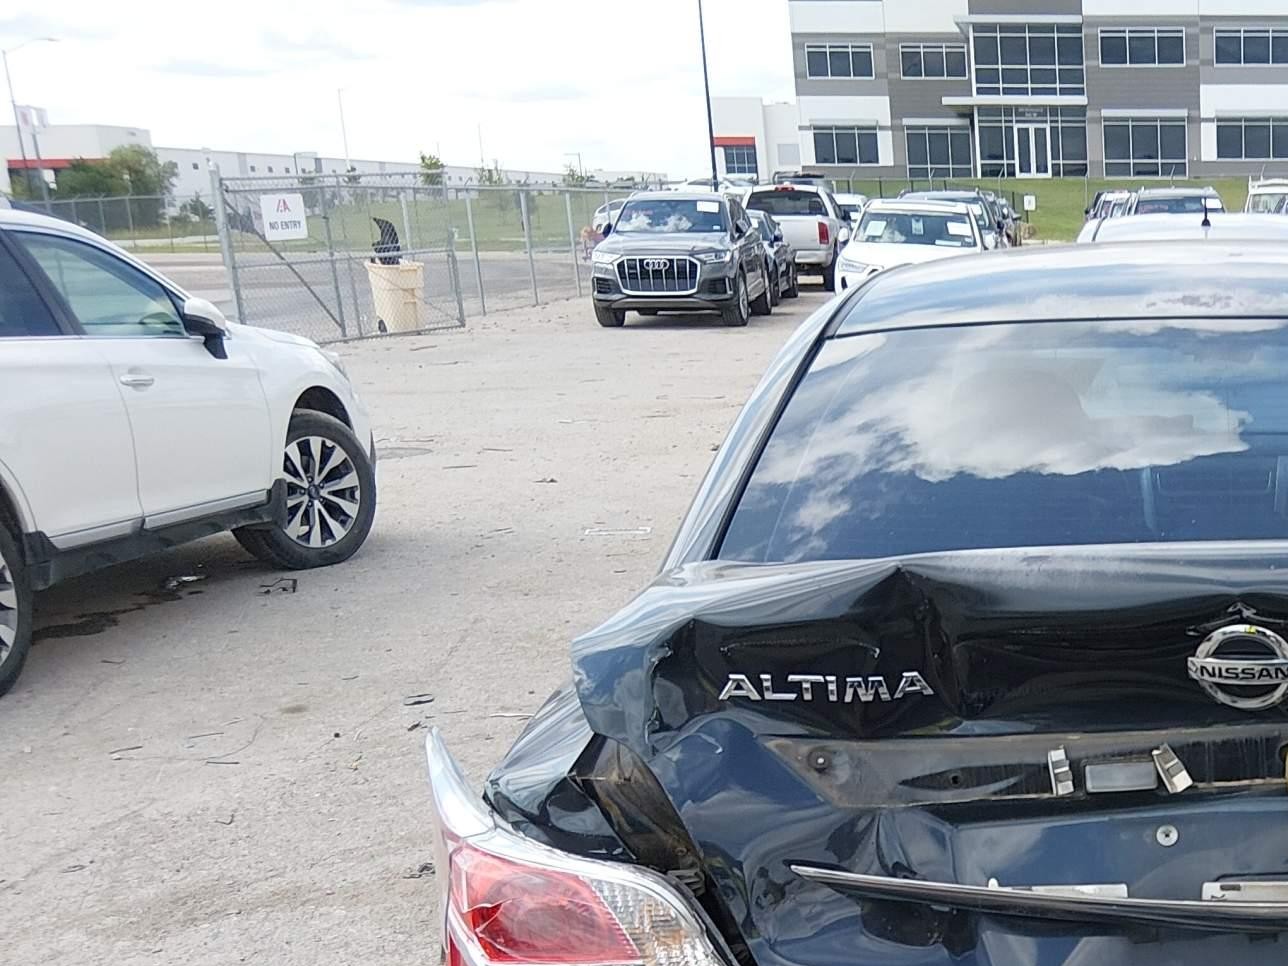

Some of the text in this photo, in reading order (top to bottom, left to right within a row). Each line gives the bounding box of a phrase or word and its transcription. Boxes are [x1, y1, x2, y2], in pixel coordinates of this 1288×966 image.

[269, 220, 301, 230] NO ENTRY
[718, 671, 935, 703] ALTIMA
